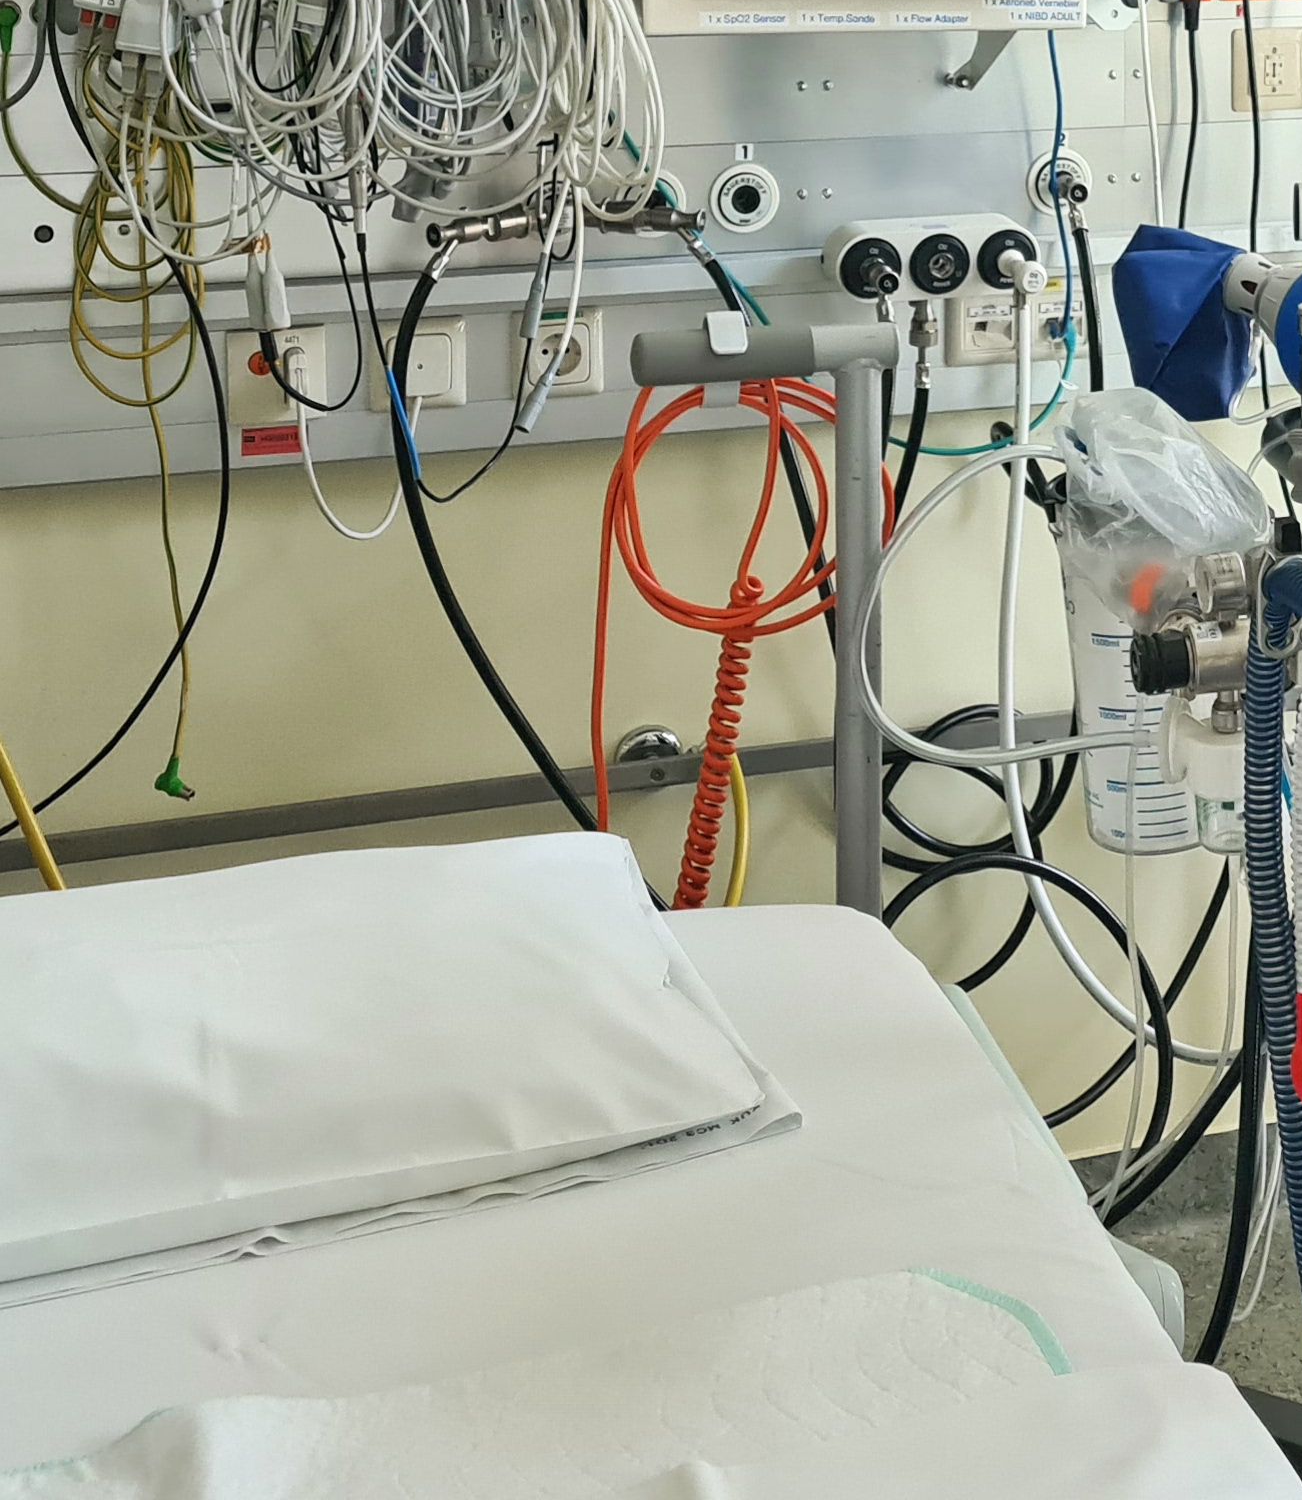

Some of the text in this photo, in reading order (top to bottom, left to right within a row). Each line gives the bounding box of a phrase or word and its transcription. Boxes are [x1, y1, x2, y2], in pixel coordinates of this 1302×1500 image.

[752, 14, 786, 23] Sensor
[911, 14, 932, 22] Flow
[934, 14, 969, 24] Adapter
[1050, 12, 1080, 20] ADULT
[742, 145, 748, 160] 1
[1092, 637, 1120, 648] 1500ml
[1099, 711, 1126, 720] 1000ml
